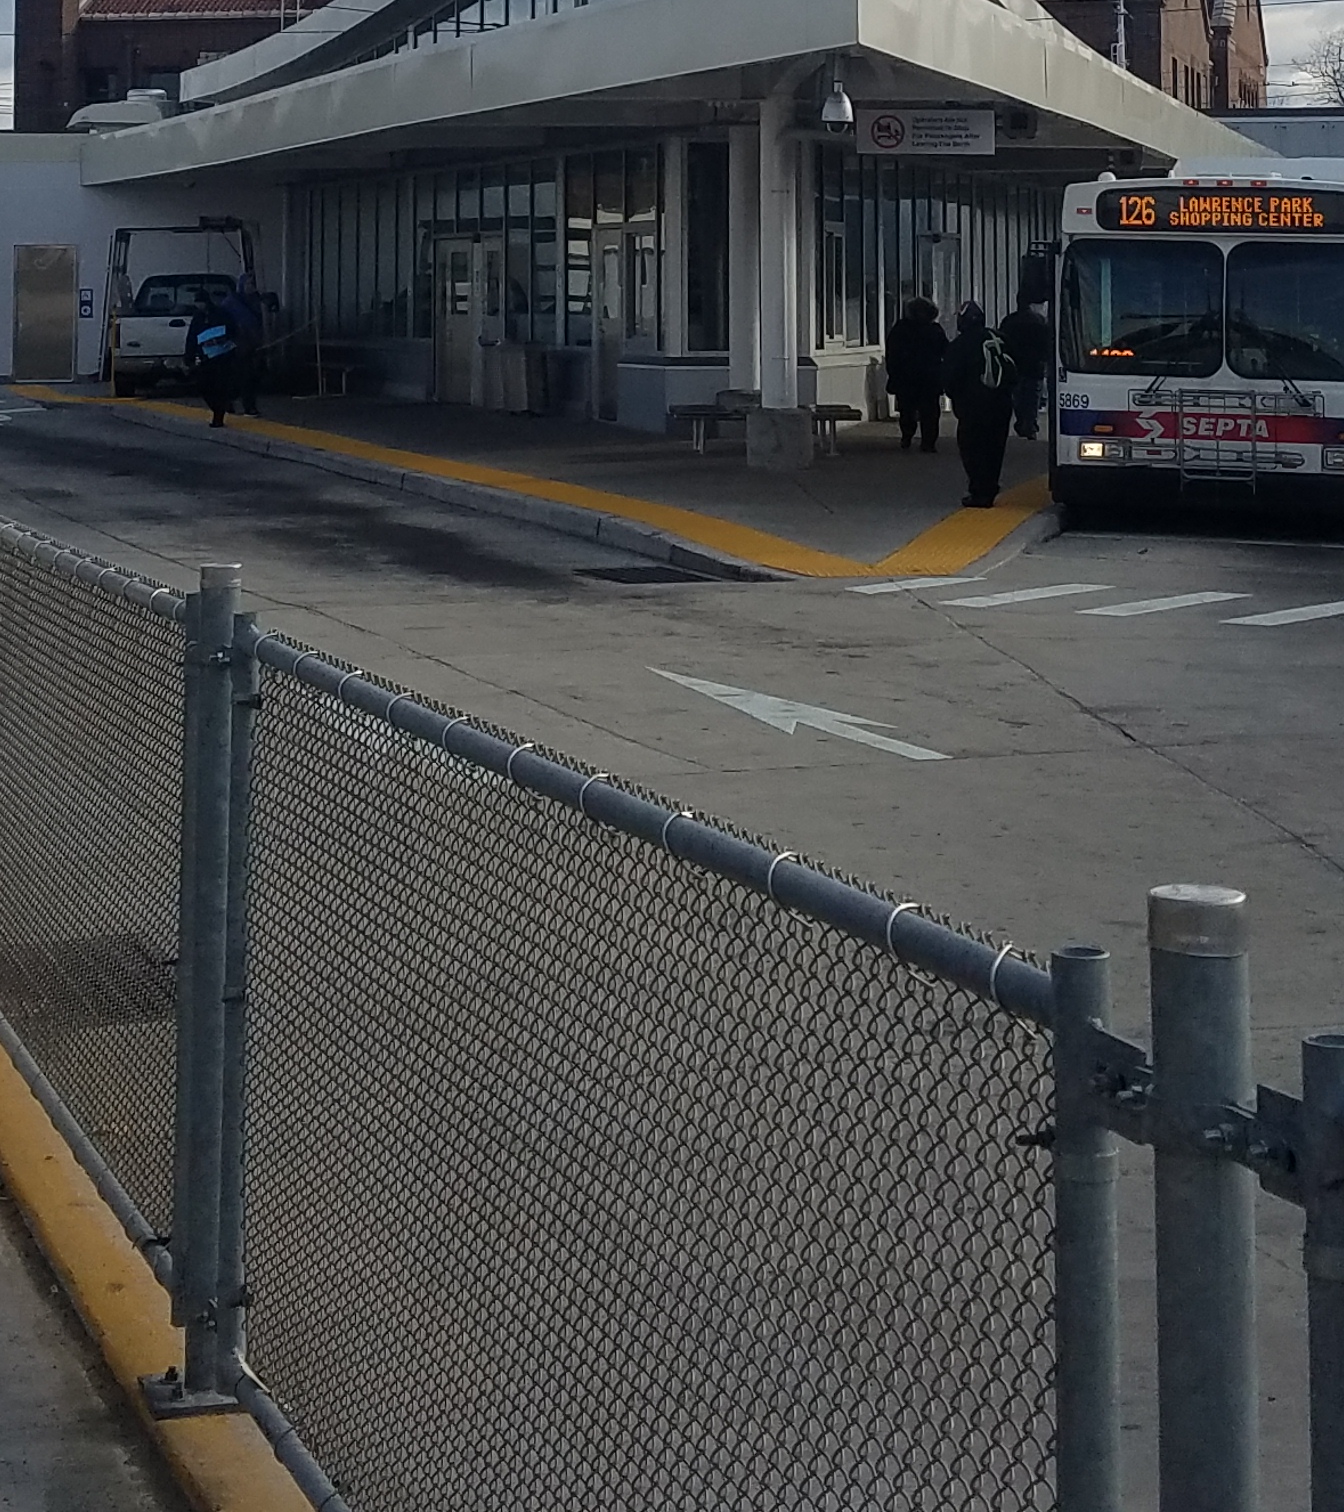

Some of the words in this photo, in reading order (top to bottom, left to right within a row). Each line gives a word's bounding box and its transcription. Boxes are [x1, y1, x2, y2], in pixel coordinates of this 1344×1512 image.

[1119, 196, 1156, 226] 126
[1179, 196, 1263, 213] LAWRENCE
[1269, 197, 1313, 213] PARK
[1169, 211, 1253, 227] SHOPPING
[1258, 212, 1324, 228] CENTER
[1059, 393, 1090, 409] 5869
[1181, 417, 1269, 438] SEPTA
